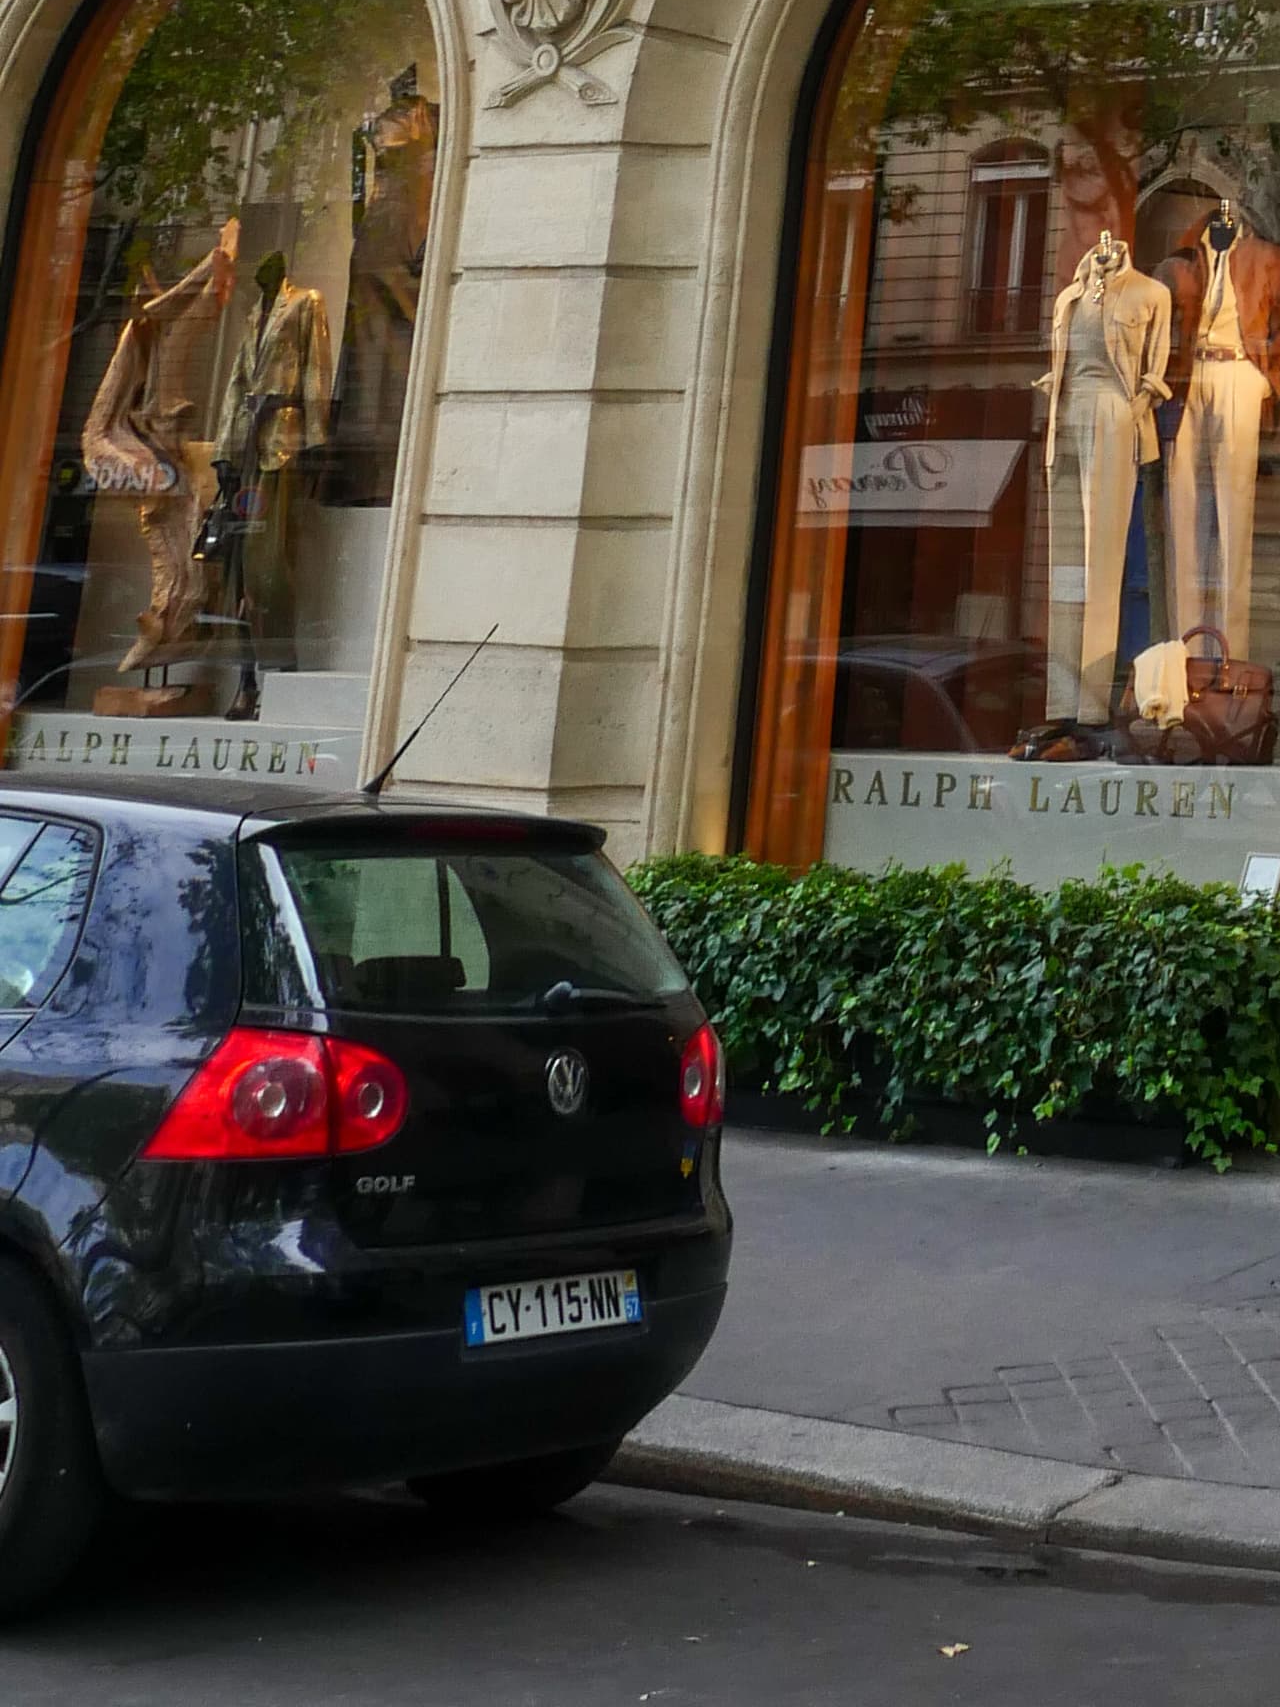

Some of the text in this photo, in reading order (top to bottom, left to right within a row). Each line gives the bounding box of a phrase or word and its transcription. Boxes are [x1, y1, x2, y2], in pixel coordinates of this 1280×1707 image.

[157, 736, 320, 775] LAUREN
[832, 769, 1235, 819] RALPH LAUREN
[356, 1175, 416, 1194] GOLF
